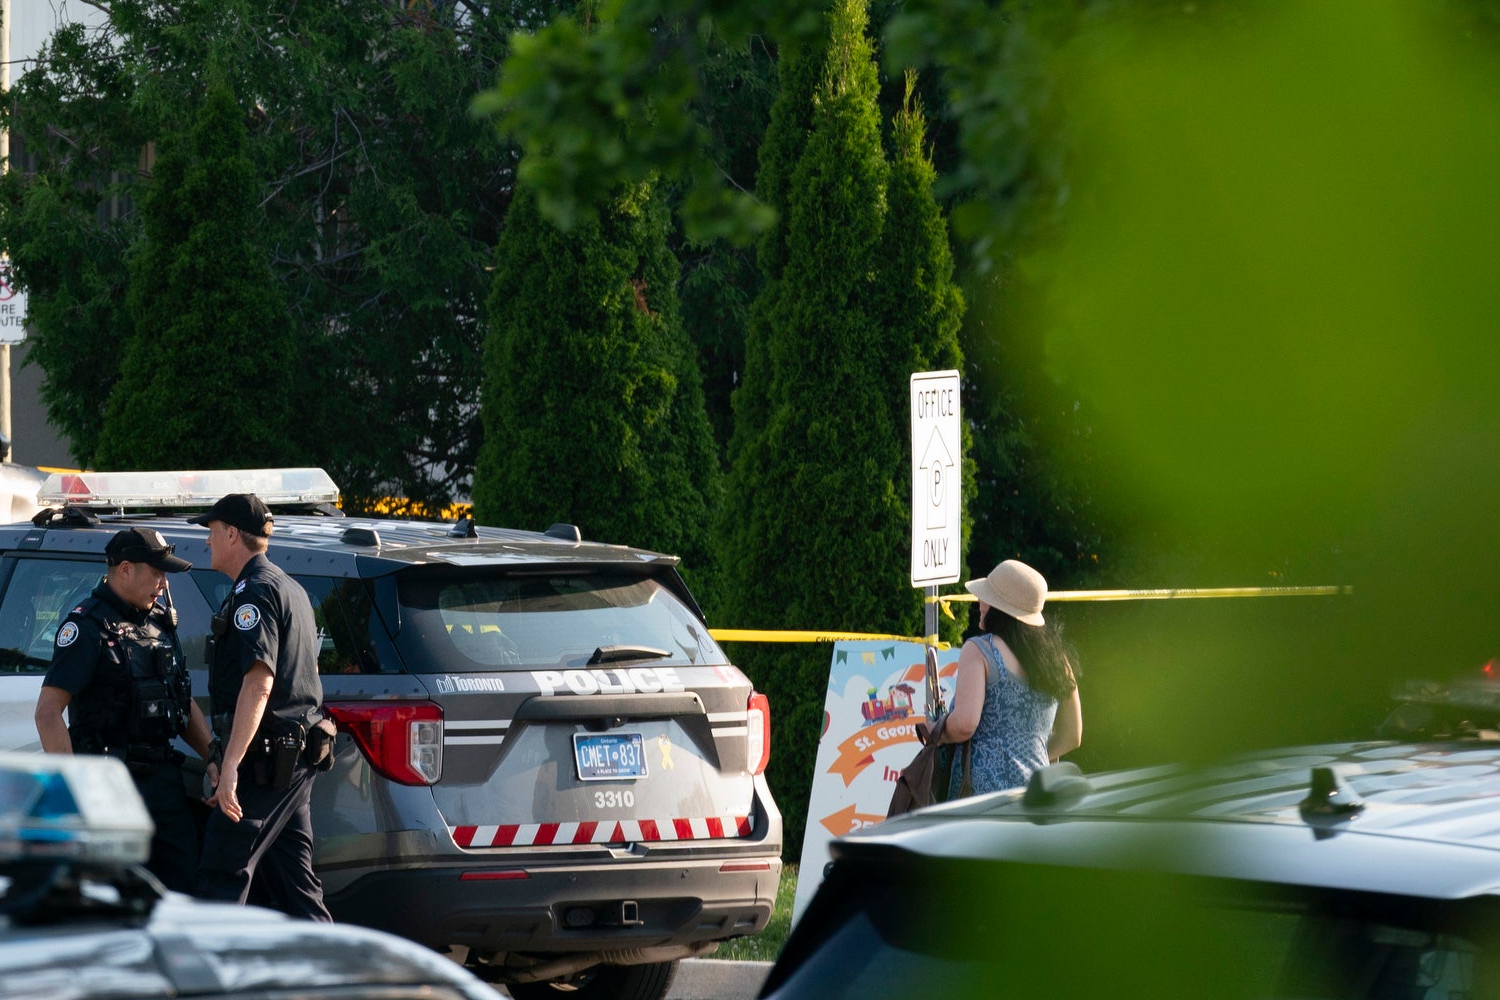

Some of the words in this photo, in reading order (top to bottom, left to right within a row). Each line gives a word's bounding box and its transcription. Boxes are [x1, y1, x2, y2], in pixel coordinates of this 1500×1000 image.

[918, 388, 954, 419] OFFICE
[923, 537, 949, 568] ONLY
[455, 676, 505, 692] TORONTO
[530, 668, 686, 697] POLICE
[854, 736, 876, 752] St.
[580, 744, 610, 768] CMET
[620, 744, 641, 766] 837
[883, 766, 905, 782] In
[594, 790, 634, 808] 3310
